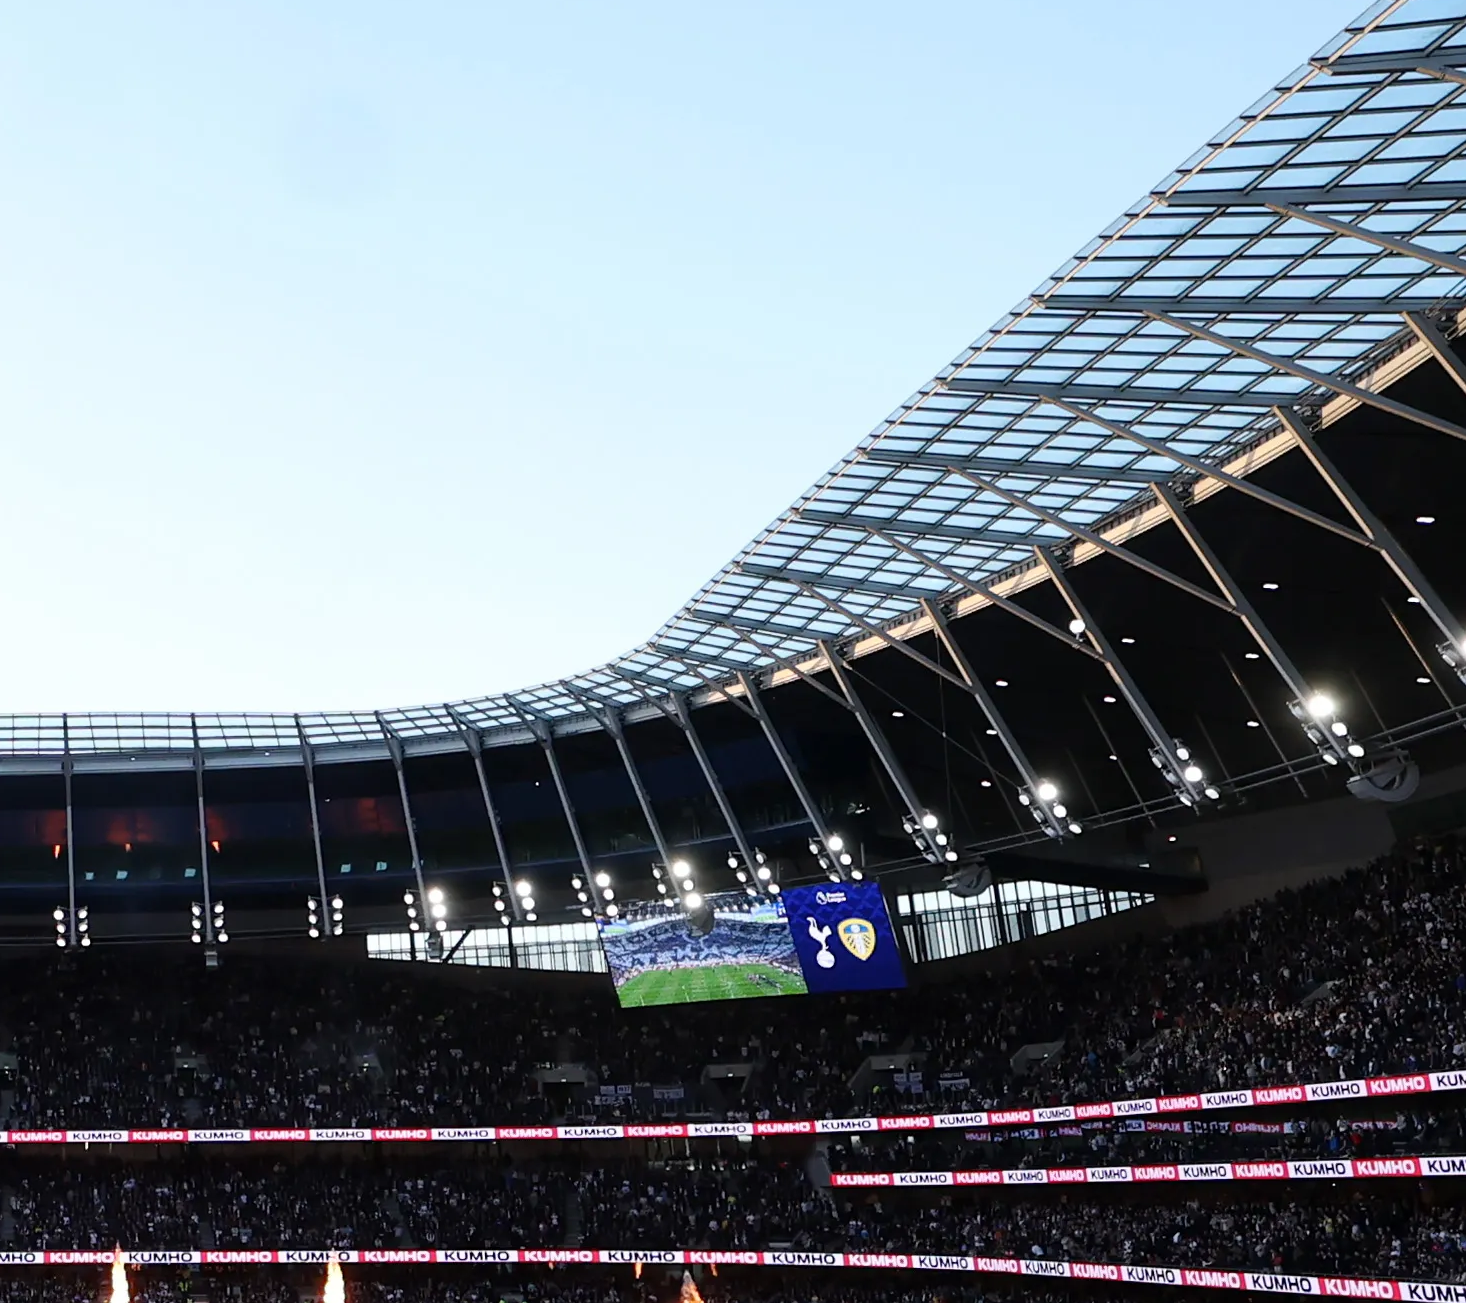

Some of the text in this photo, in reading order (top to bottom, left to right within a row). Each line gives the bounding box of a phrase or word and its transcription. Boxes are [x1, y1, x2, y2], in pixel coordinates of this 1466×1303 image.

[1370, 1076, 1425, 1094] KUMHO
[499, 1128, 553, 1138] KUMHO
[564, 1127, 617, 1137] KUMHO
[628, 1126, 683, 1136] KUMHO
[693, 1125, 747, 1134] KUMHO
[757, 1122, 811, 1134] KUMHO
[132, 1131, 184, 1141] KUMHO
[375, 1130, 427, 1139] KUMHO
[437, 1130, 489, 1139] KUMHO
[1293, 1162, 1346, 1176] KUMHO
[1356, 1160, 1415, 1175] KUMHO
[836, 1174, 889, 1184] KUMHO
[129, 1252, 193, 1263] KUMHO
[207, 1251, 272, 1262] KUMHO
[364, 1251, 430, 1262] KUMHO
[444, 1250, 510, 1261] KUMHO
[524, 1251, 593, 1262] KUMHO
[608, 1251, 675, 1262] KUMHO
[690, 1252, 758, 1264] KUMHO
[772, 1253, 836, 1265] KUMHO
[848, 1255, 908, 1267] KUMHO
[1185, 1270, 1241, 1288] KUMHO
[1251, 1274, 1312, 1293] KUMHO
[1324, 1279, 1394, 1299] KUMHO
